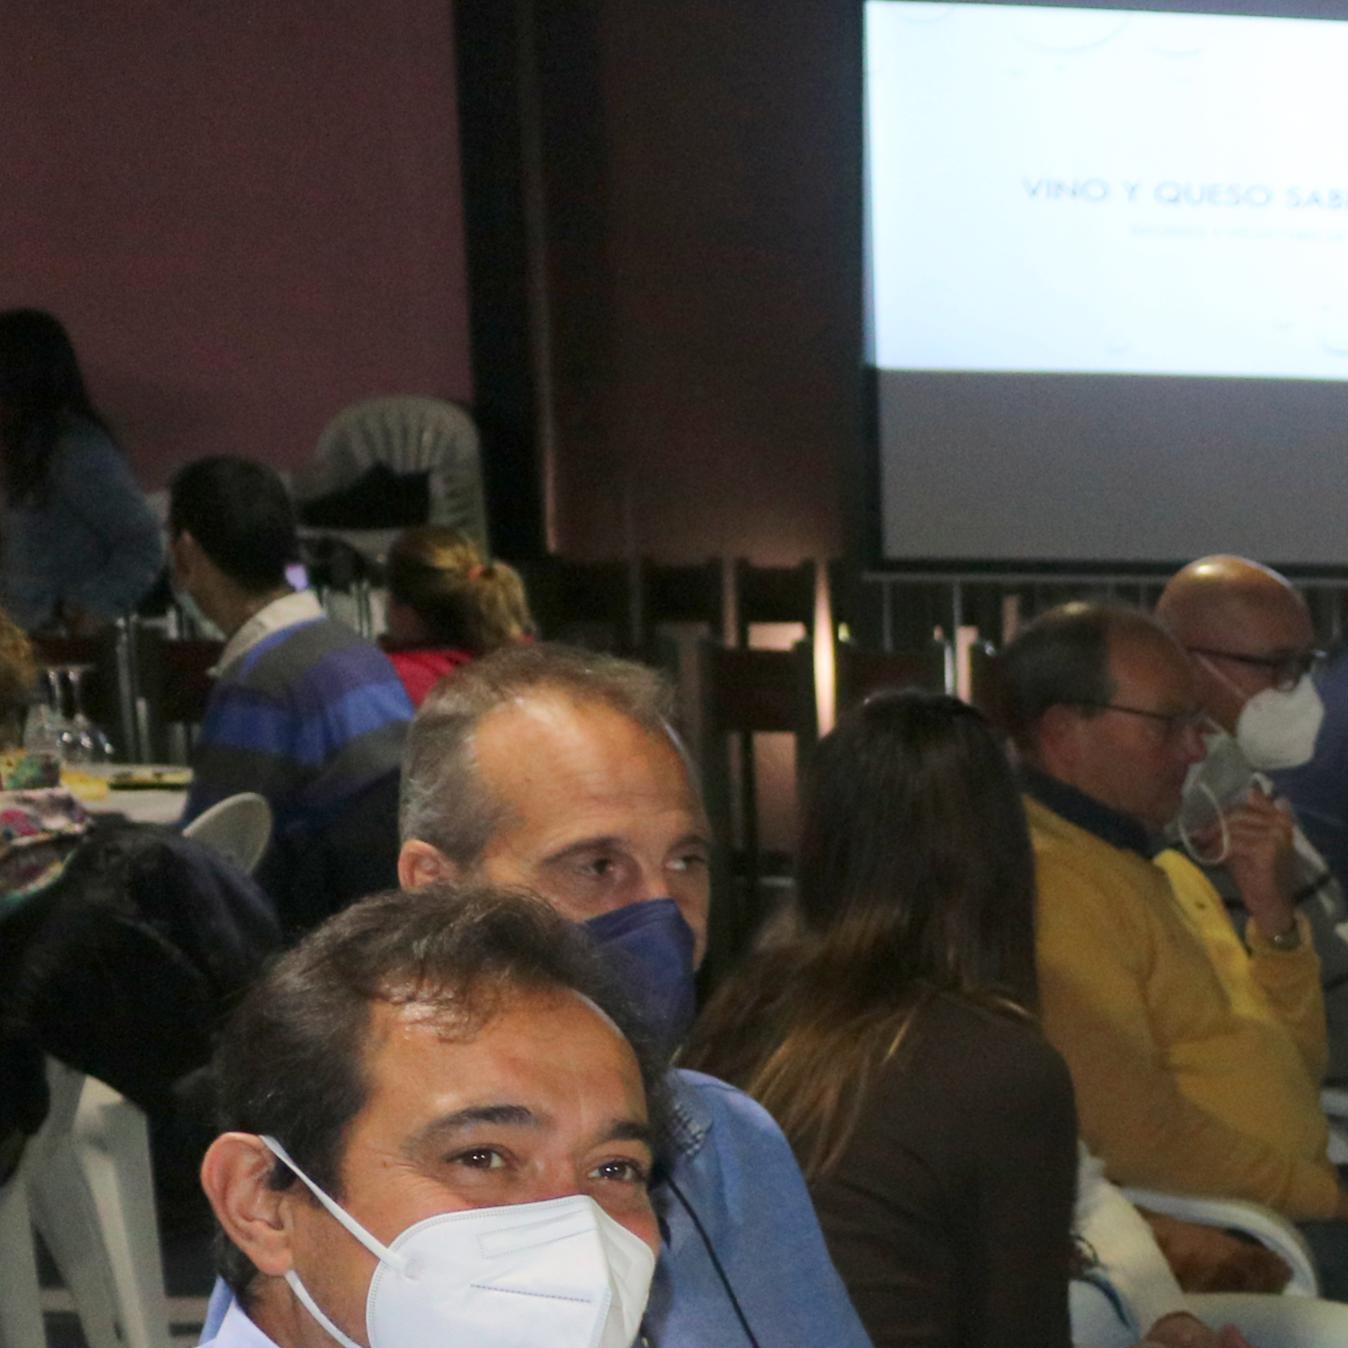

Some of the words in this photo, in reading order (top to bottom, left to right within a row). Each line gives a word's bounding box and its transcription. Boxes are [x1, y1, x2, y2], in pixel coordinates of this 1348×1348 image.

[1020, 177, 1111, 203] VINO
[1120, 178, 1143, 203] Y
[1153, 180, 1273, 207] QUESO
